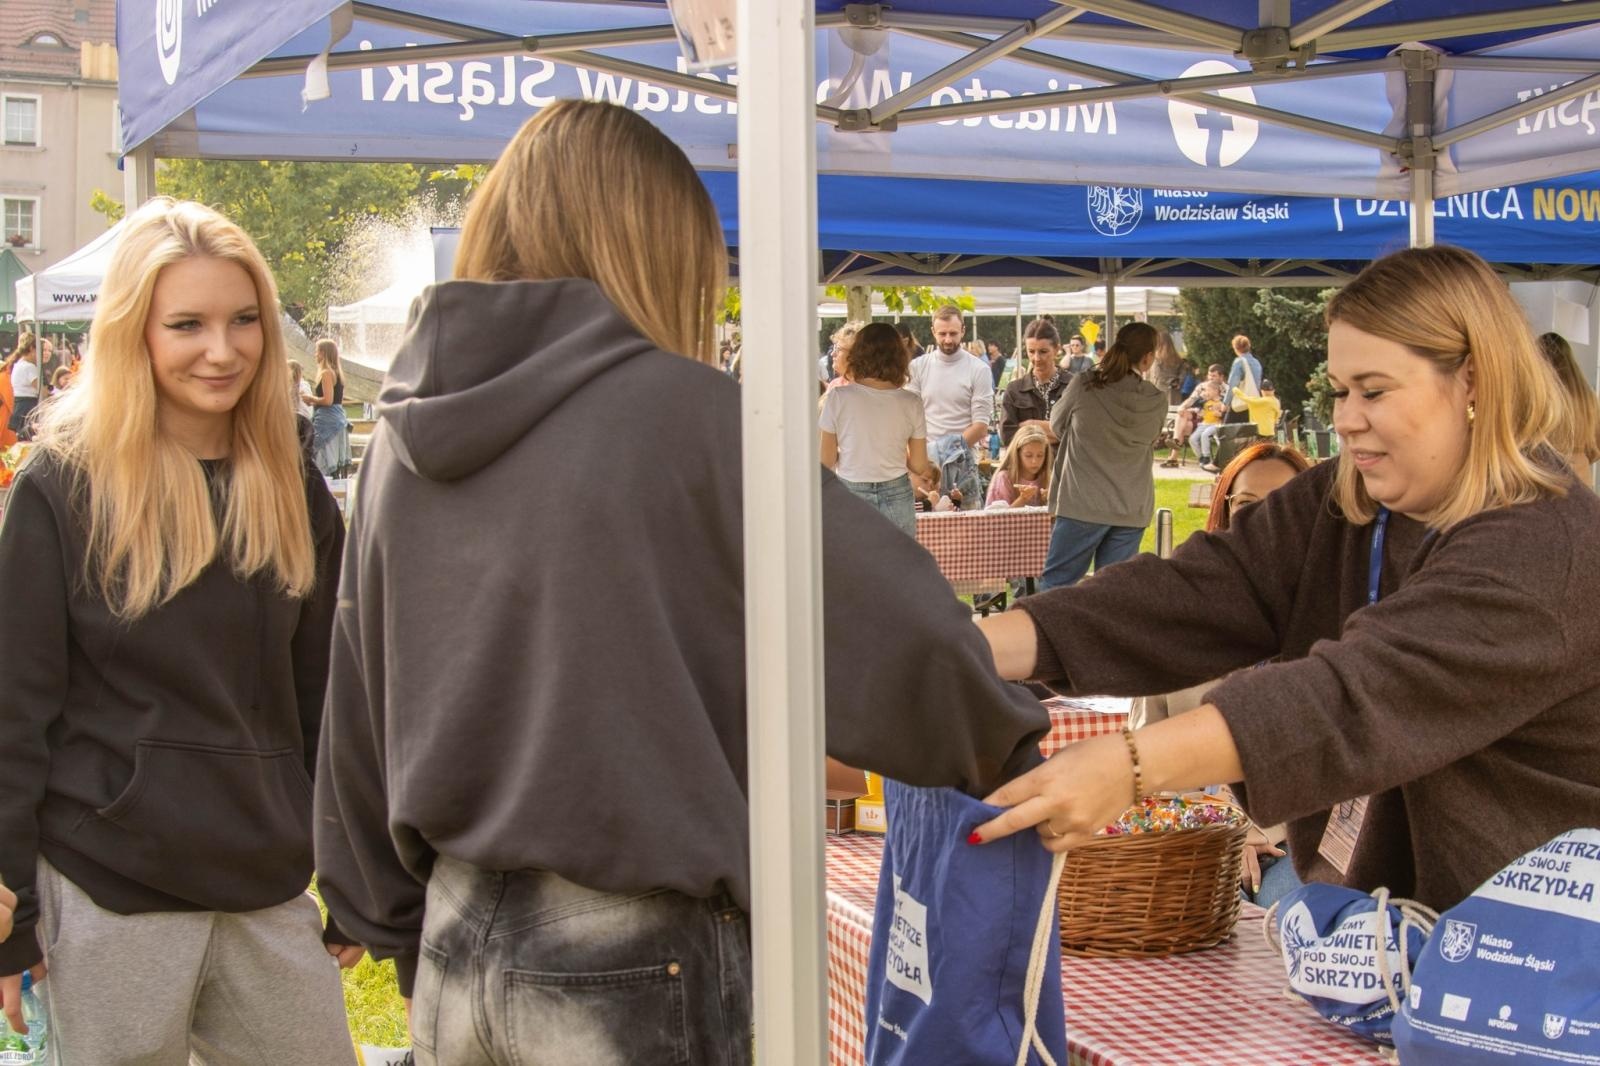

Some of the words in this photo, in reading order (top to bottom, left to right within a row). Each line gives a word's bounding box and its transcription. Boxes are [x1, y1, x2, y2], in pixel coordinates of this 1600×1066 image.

[1154, 203, 1239, 221] Wodzisław
[1242, 201, 1290, 223] Śląski
[1528, 856, 1572, 873] SWOJE
[1492, 870, 1595, 903] SKRZYDŁA
[1480, 933, 1513, 950] Miasto
[1303, 951, 1327, 963] POD
[1331, 953, 1376, 967] SWOJE
[1476, 947, 1524, 966] Wodzisław
[1524, 953, 1556, 972] Śląski
